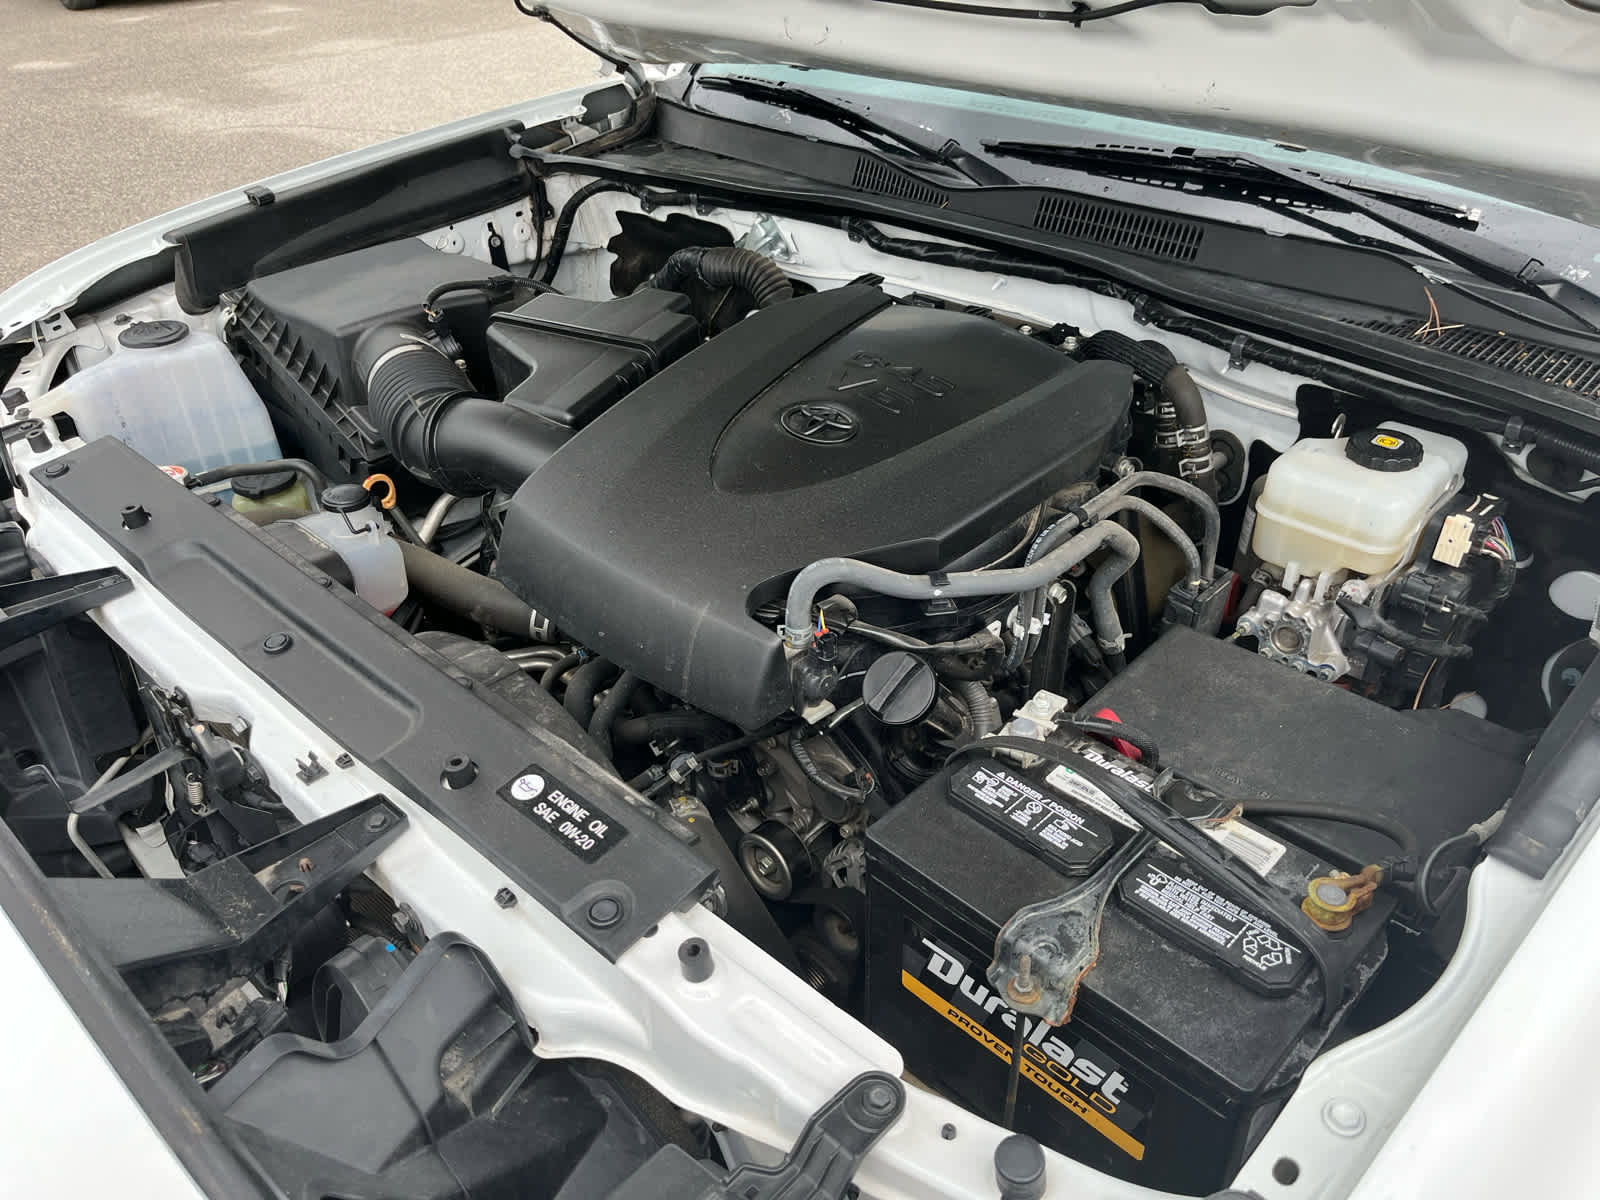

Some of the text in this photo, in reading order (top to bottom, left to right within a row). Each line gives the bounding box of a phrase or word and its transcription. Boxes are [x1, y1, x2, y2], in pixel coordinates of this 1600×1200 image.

[1083, 748, 1154, 792] Duralast
[547, 790, 609, 839] ENGINE OIL
[1005, 776, 1043, 801] DANGER
[1048, 801, 1086, 825] POISON
[533, 802, 595, 850] SAE 0W-20
[922, 937, 1128, 1105] Duralast
[1023, 1043, 1117, 1115] GOLD
[1024, 1063, 1089, 1115] TOUGH
